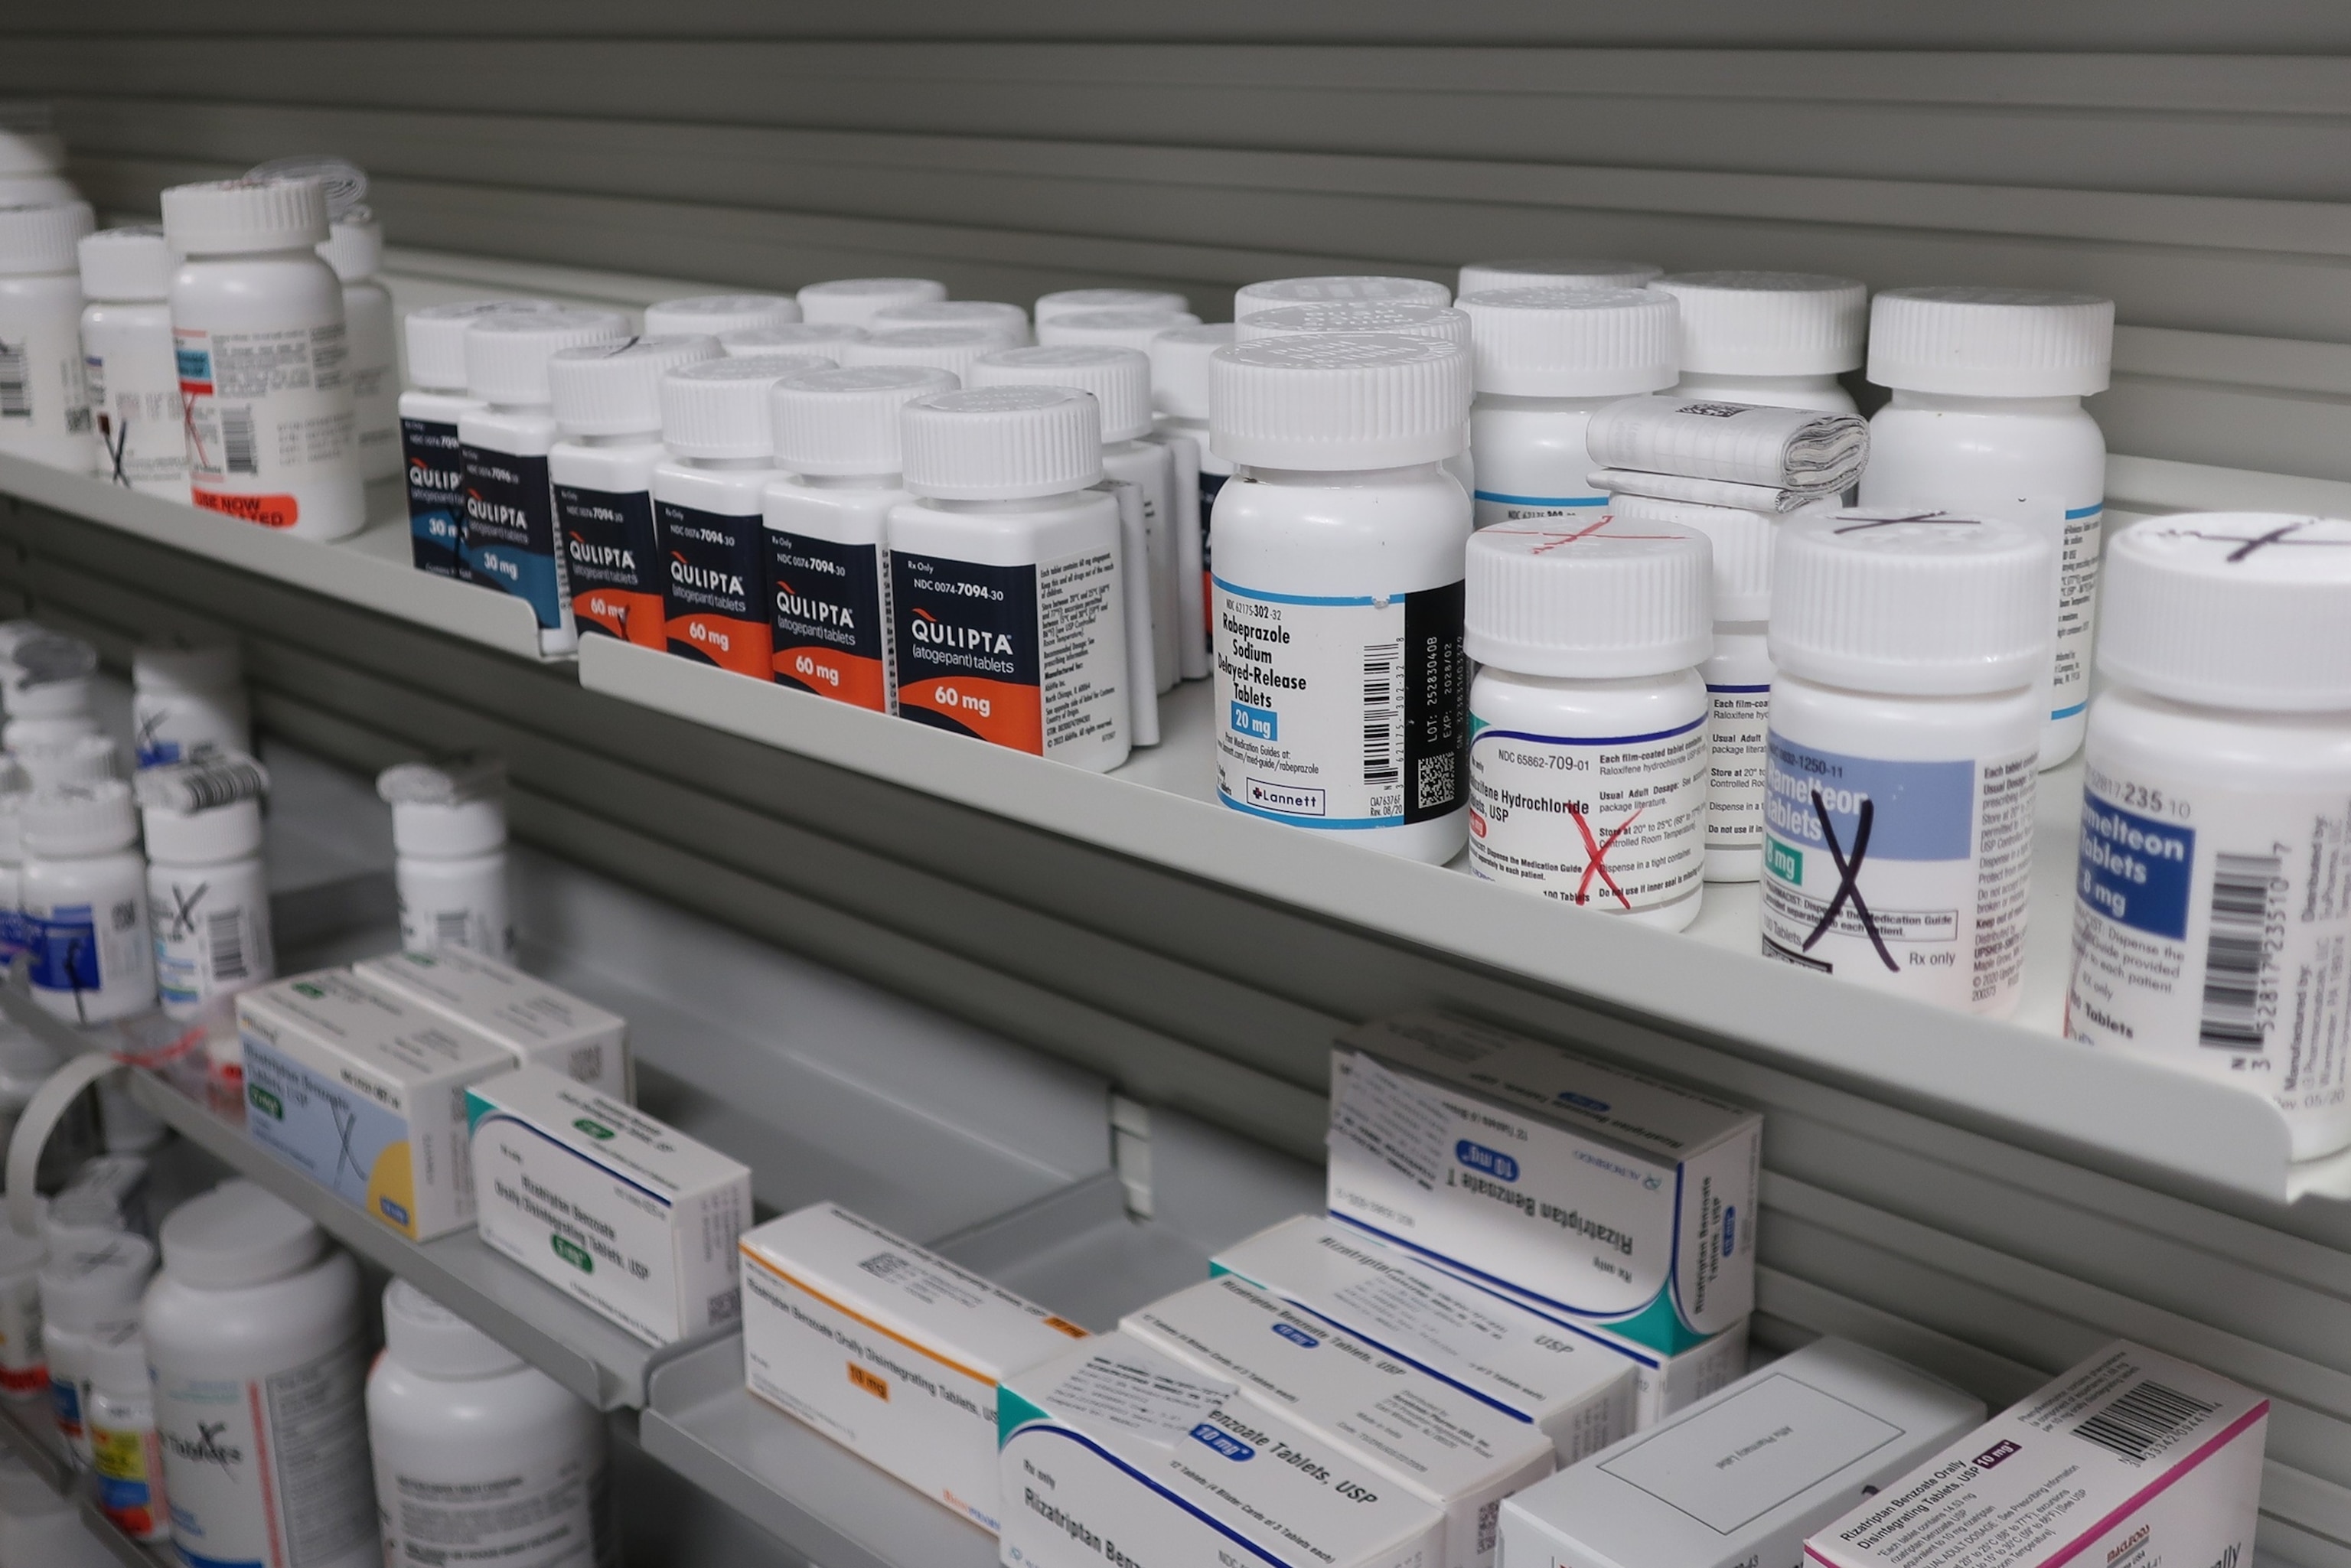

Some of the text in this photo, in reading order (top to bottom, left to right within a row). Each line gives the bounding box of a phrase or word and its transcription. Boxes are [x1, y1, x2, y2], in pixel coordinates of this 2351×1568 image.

[409, 465, 461, 491] QULIP
[222, 497, 260, 516] NOW
[468, 497, 528, 530] QULIPTA
[429, 517, 446, 536] 30
[484, 551, 497, 571] 30
[499, 560, 518, 581] mg
[569, 540, 636, 570] QULIPTA
[777, 553, 846, 577] NDC 0074-7094-30
[610, 569, 639, 586] tablets
[671, 560, 744, 596] QULIPTA
[914, 578, 1004, 601] NDC 0074-7094-30
[591, 598, 607, 616] 60
[672, 583, 747, 613] (atogepant) tablets
[776, 591, 855, 629] QULIPTA
[690, 621, 729, 651] 60 mg
[778, 614, 856, 647] (atogepant) tablets
[911, 619, 1013, 655] QULIPTA
[1223, 611, 1290, 644] Rabeprazole
[912, 644, 1014, 674] (atogepant) tablets
[1232, 638, 1272, 663] Sodium
[796, 655, 840, 687] 60 mg
[1218, 651, 1306, 690] Delayed-Release
[934, 686, 991, 718] 60 mg
[1233, 682, 1272, 708] Tablets
[1426, 636, 1437, 743] LOT: 25283040B
[1443, 643, 1453, 738] EXP: 2028/02
[1235, 709, 1271, 739] 20 mg
[1714, 710, 1754, 720] Raloxifene
[1234, 736, 1280, 758] Medication Guides
[1498, 748, 1590, 771] NDC 65862-709-01
[1622, 743, 1684, 762] film-coated tablet
[1711, 745, 1744, 755] package
[1599, 755, 1686, 776] Raloxifene hydrochloride
[1710, 767, 1732, 777] Store
[1599, 788, 1649, 800] Usual Adult
[1710, 778, 1749, 788] Controlled
[1263, 789, 1316, 808] Lannett
[1383, 804, 1403, 817] 08/20
[1502, 789, 1590, 815] Hydrochloride
[1599, 802, 1632, 813] package
[1709, 801, 1744, 812] Dispense
[1489, 804, 1509, 823] USP
[1641, 833, 1662, 845] Room
[2087, 807, 2184, 862] melteon
[1486, 846, 1559, 872] Dispense Medication
[1766, 839, 1795, 881] 8 mg
[2083, 869, 2126, 918] 8 mg
[1841, 921, 1865, 933] each
[1924, 914, 1952, 925] Guide
[2108, 925, 2185, 962] Dispense the
[1909, 950, 1955, 967] Rx only
[2092, 937, 2180, 979] Guide provided
[2100, 960, 2125, 979] each
[2093, 981, 2114, 1002] only
[2085, 1002, 2134, 1038] Tablets
[1492, 1153, 1515, 1179] 10
[1460, 1171, 1536, 1217] Benzoate
[520, 1173, 617, 1242] Rizatriptan Benzoate
[494, 1178, 521, 1210] Orally
[521, 1195, 586, 1247] Disintegrating
[627, 1257, 650, 1281] USP
[1540, 1202, 1633, 1256] Rizatriptan
[1593, 1256, 1616, 1275] only
[1319, 1236, 1574, 1355] Rizatripta USP
[1221, 1280, 1407, 1376] Rizatriptan Benzoate Tablets, USP
[791, 1304, 833, 1339] Benzoate
[834, 1330, 864, 1359] Orally
[864, 1346, 937, 1397] Disintegrating
[866, 1378, 887, 1399] mg
[1192, 1425, 1215, 1441] 10
[1207, 1409, 1378, 1504] enzoate Tablets, USP
[2144, 1435, 2180, 1460] 33342
[1978, 1456, 1994, 1467] 10
[1036, 1469, 1056, 1491] only
[1840, 1459, 1968, 1541] Rizatriptan Benzoate Orally
[1857, 1465, 1981, 1550] Disintegrating Tablets, USP
[2036, 1488, 2071, 1513] excursions
[1025, 1486, 1102, 1554] Rizatriptan
[1181, 1466, 1336, 1564] Tablets Blister Cards Tablets each)
[1922, 1520, 1953, 1542] benzoate
[1951, 1508, 1968, 1523] USP
[1942, 1464, 2081, 1563] ADULT DOSAGE Prescribing Information
[1964, 1505, 1997, 1529] rizatriptan
[1898, 1511, 1948, 1544] tablet contains
